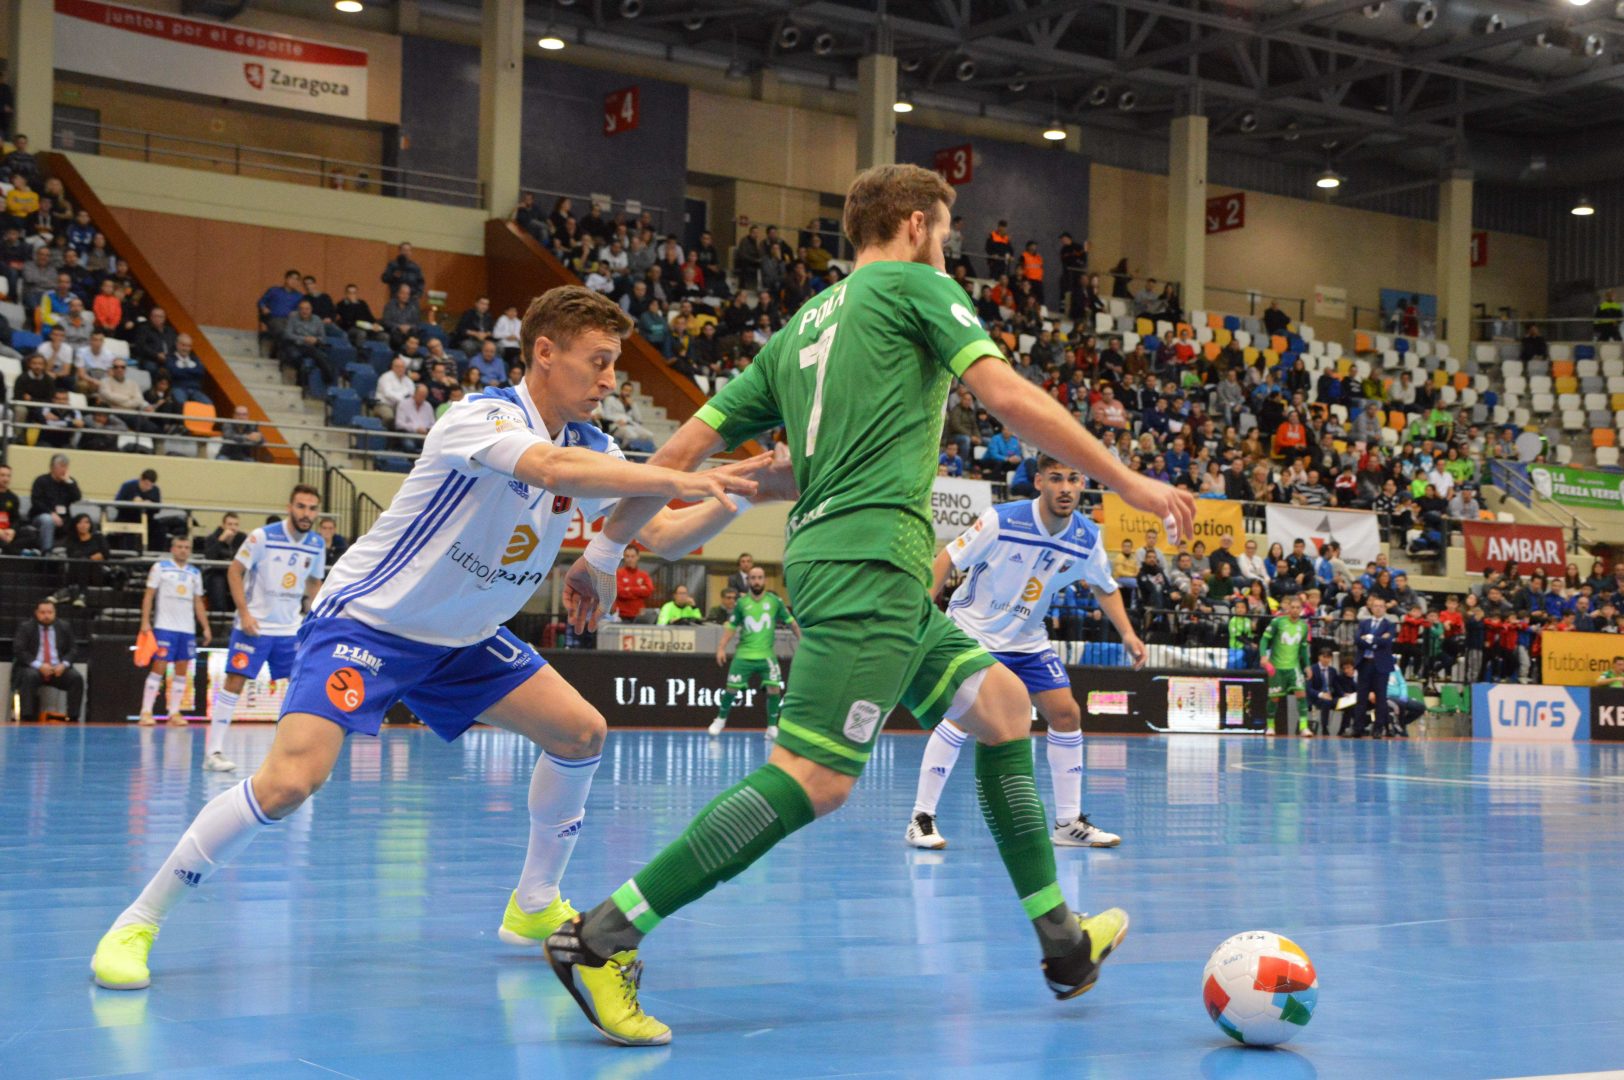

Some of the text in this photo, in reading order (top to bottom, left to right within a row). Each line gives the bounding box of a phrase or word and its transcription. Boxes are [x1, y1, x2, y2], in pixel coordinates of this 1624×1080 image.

[104, 8, 303, 56] juntos por el deporte
[271, 69, 349, 97] Zaragoza
[621, 92, 634, 123] 4
[953, 150, 966, 179] 3
[1226, 200, 1239, 225] 2
[1552, 472, 1565, 483] LA
[288, 552, 299, 567] 6
[1032, 549, 1056, 571] 14
[1487, 536, 1562, 565] AMBAR
[333, 643, 385, 672] D-Link
[639, 637, 694, 652] Zaragoza
[613, 677, 657, 706] Un
